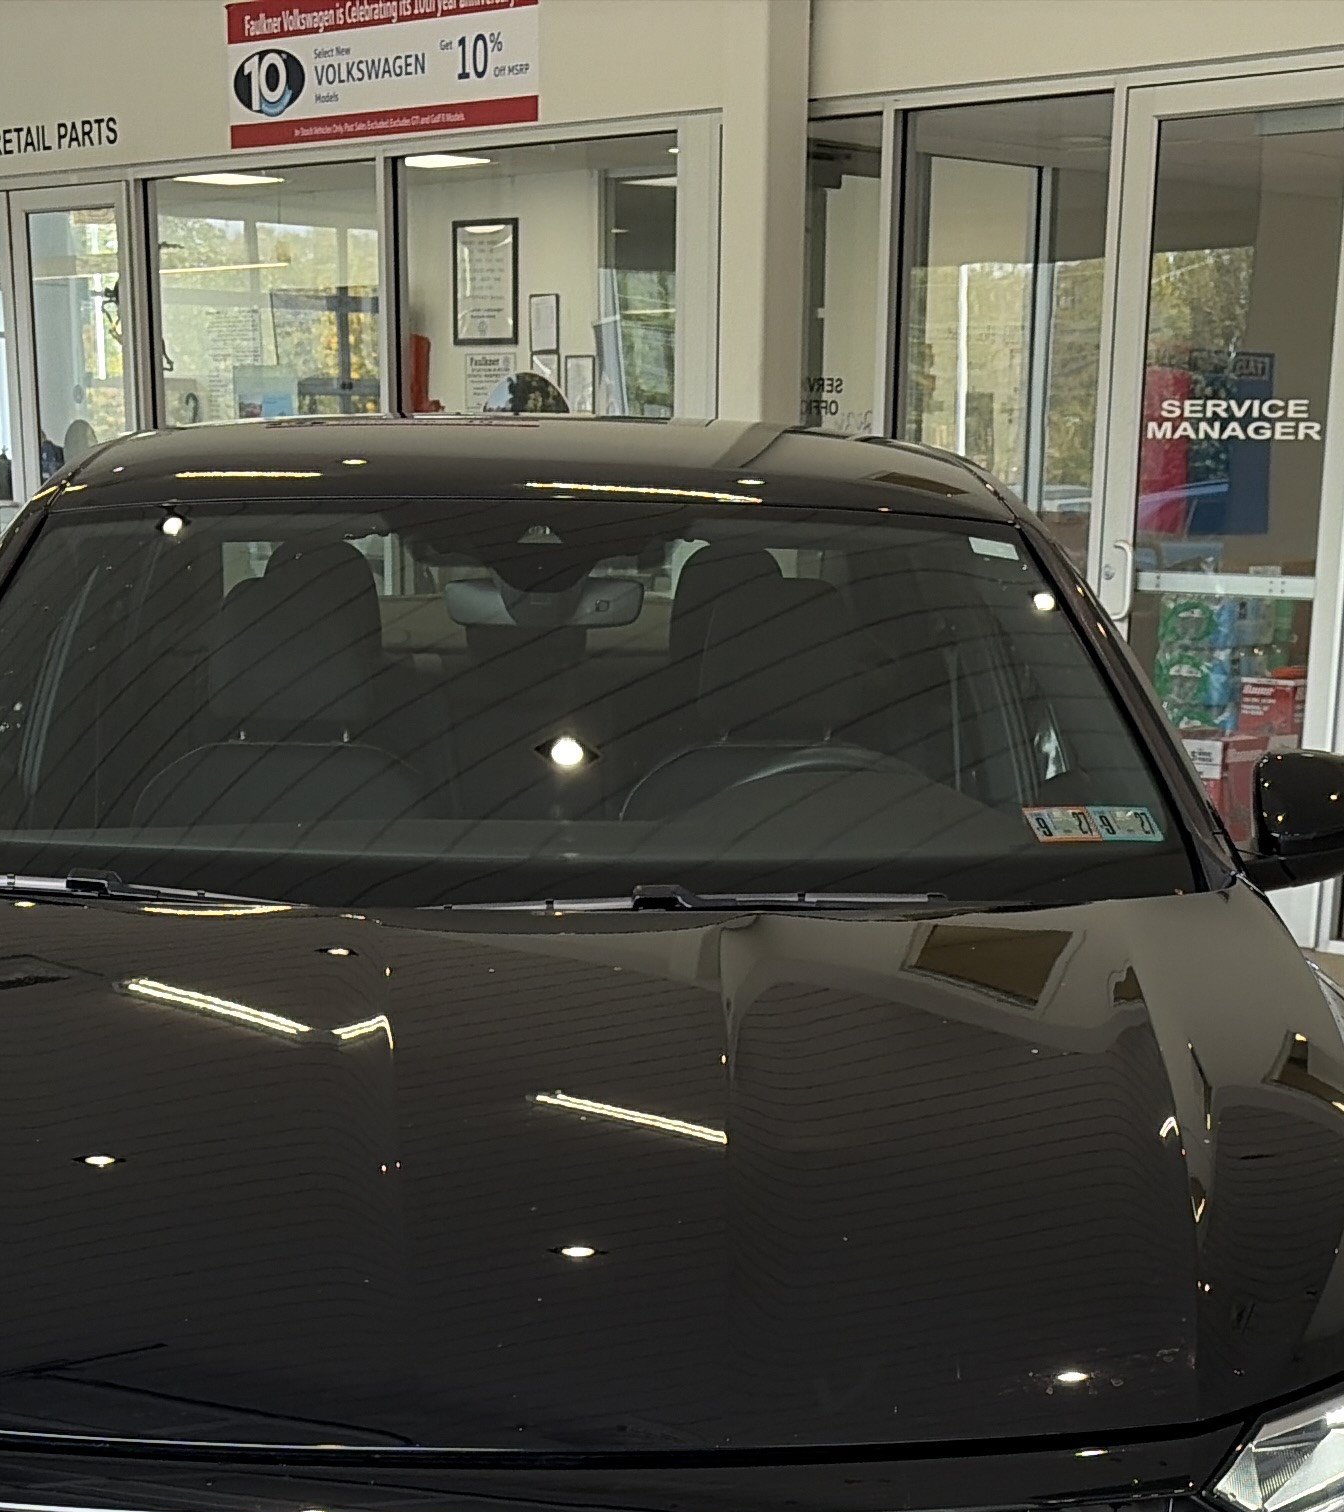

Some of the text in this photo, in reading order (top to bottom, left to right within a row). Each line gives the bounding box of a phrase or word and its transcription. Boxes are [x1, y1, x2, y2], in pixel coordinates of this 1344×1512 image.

[244, 13, 281, 36] Faulkner
[282, 8, 335, 33] Volkswagen
[335, 3, 344, 25] is
[345, 1, 397, 23] Celebrating
[314, 46, 351, 59] Select New
[439, 39, 453, 51] Get
[315, 52, 426, 86] VOLKSWAGEN
[507, 63, 530, 76] MSRP
[315, 93, 339, 104] Models
[57, 117, 118, 150] PARTS
[1161, 399, 1309, 419] SERVICE
[1146, 421, 1321, 440] MANAGER
